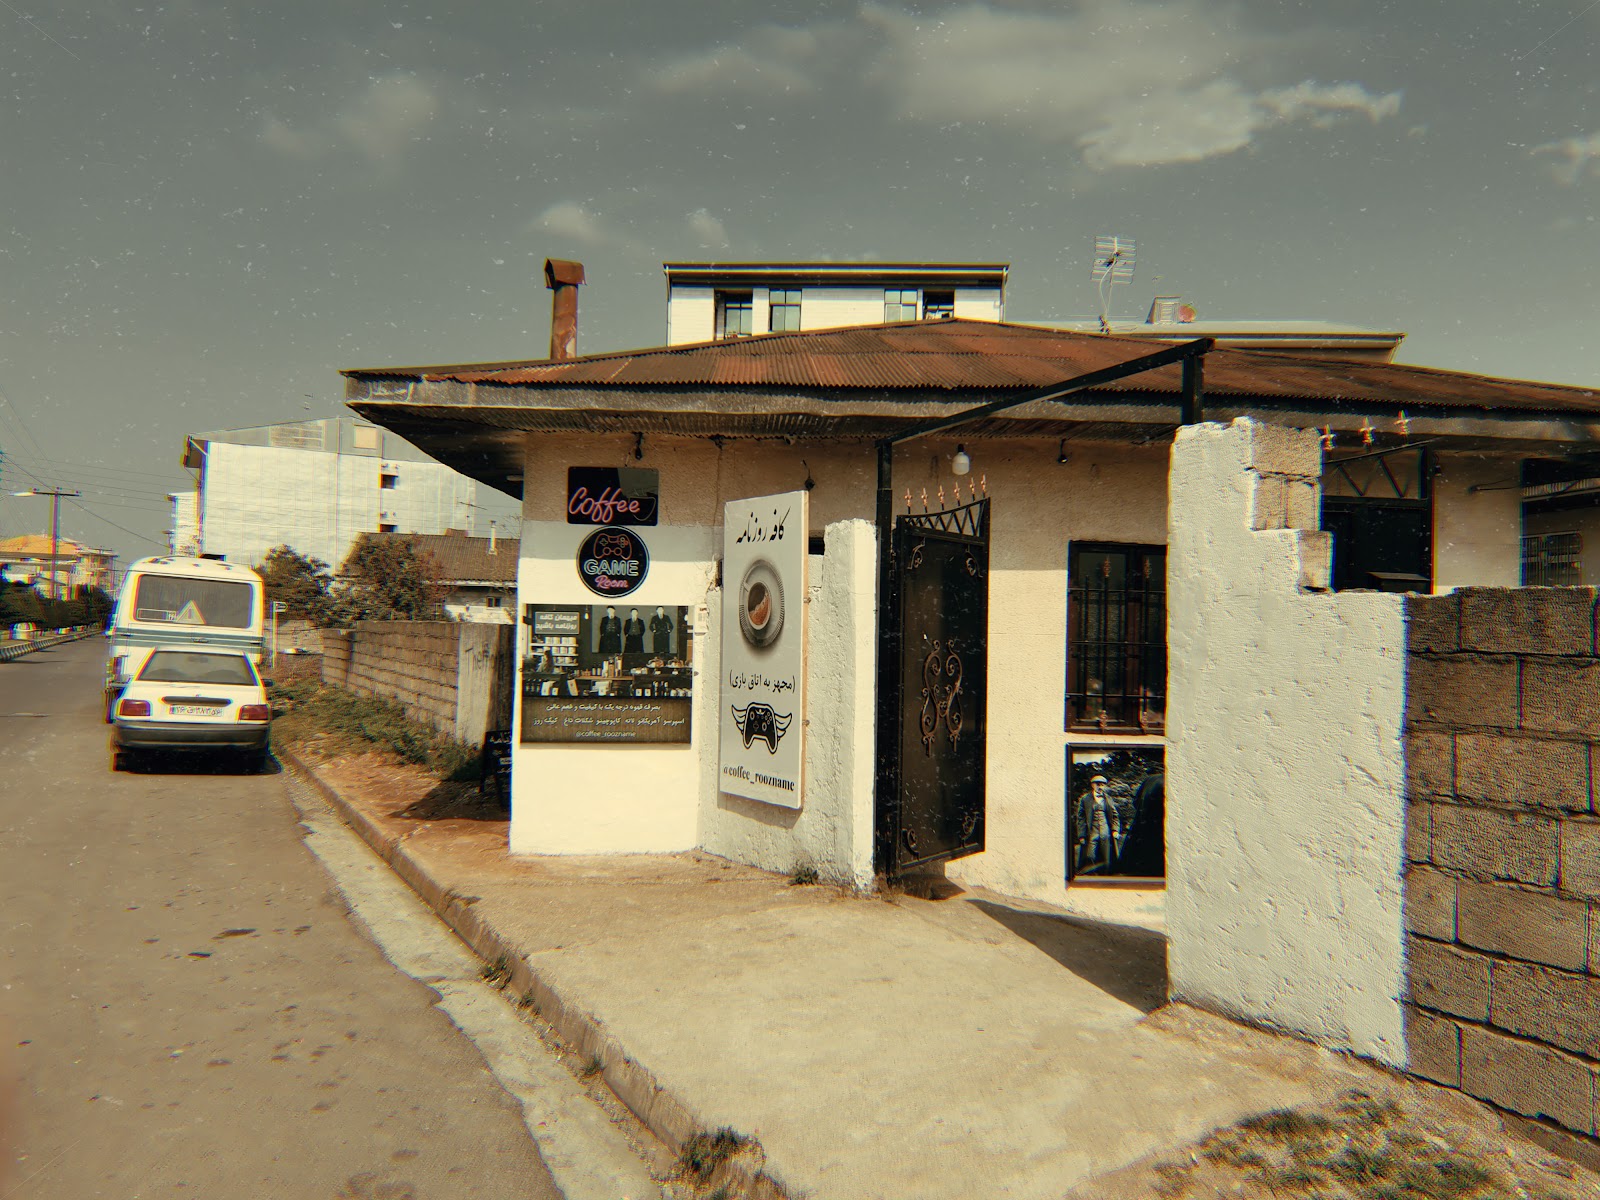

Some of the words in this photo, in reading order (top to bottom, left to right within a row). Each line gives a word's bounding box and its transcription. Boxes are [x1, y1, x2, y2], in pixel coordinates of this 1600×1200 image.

[568, 486, 641, 524] Coffee
[735, 511, 768, 545] روزنامه
[768, 505, 792, 543] کافه
[583, 559, 640, 577] GAME
[594, 574, 629, 590] Room
[747, 673, 762, 690] اتاق
